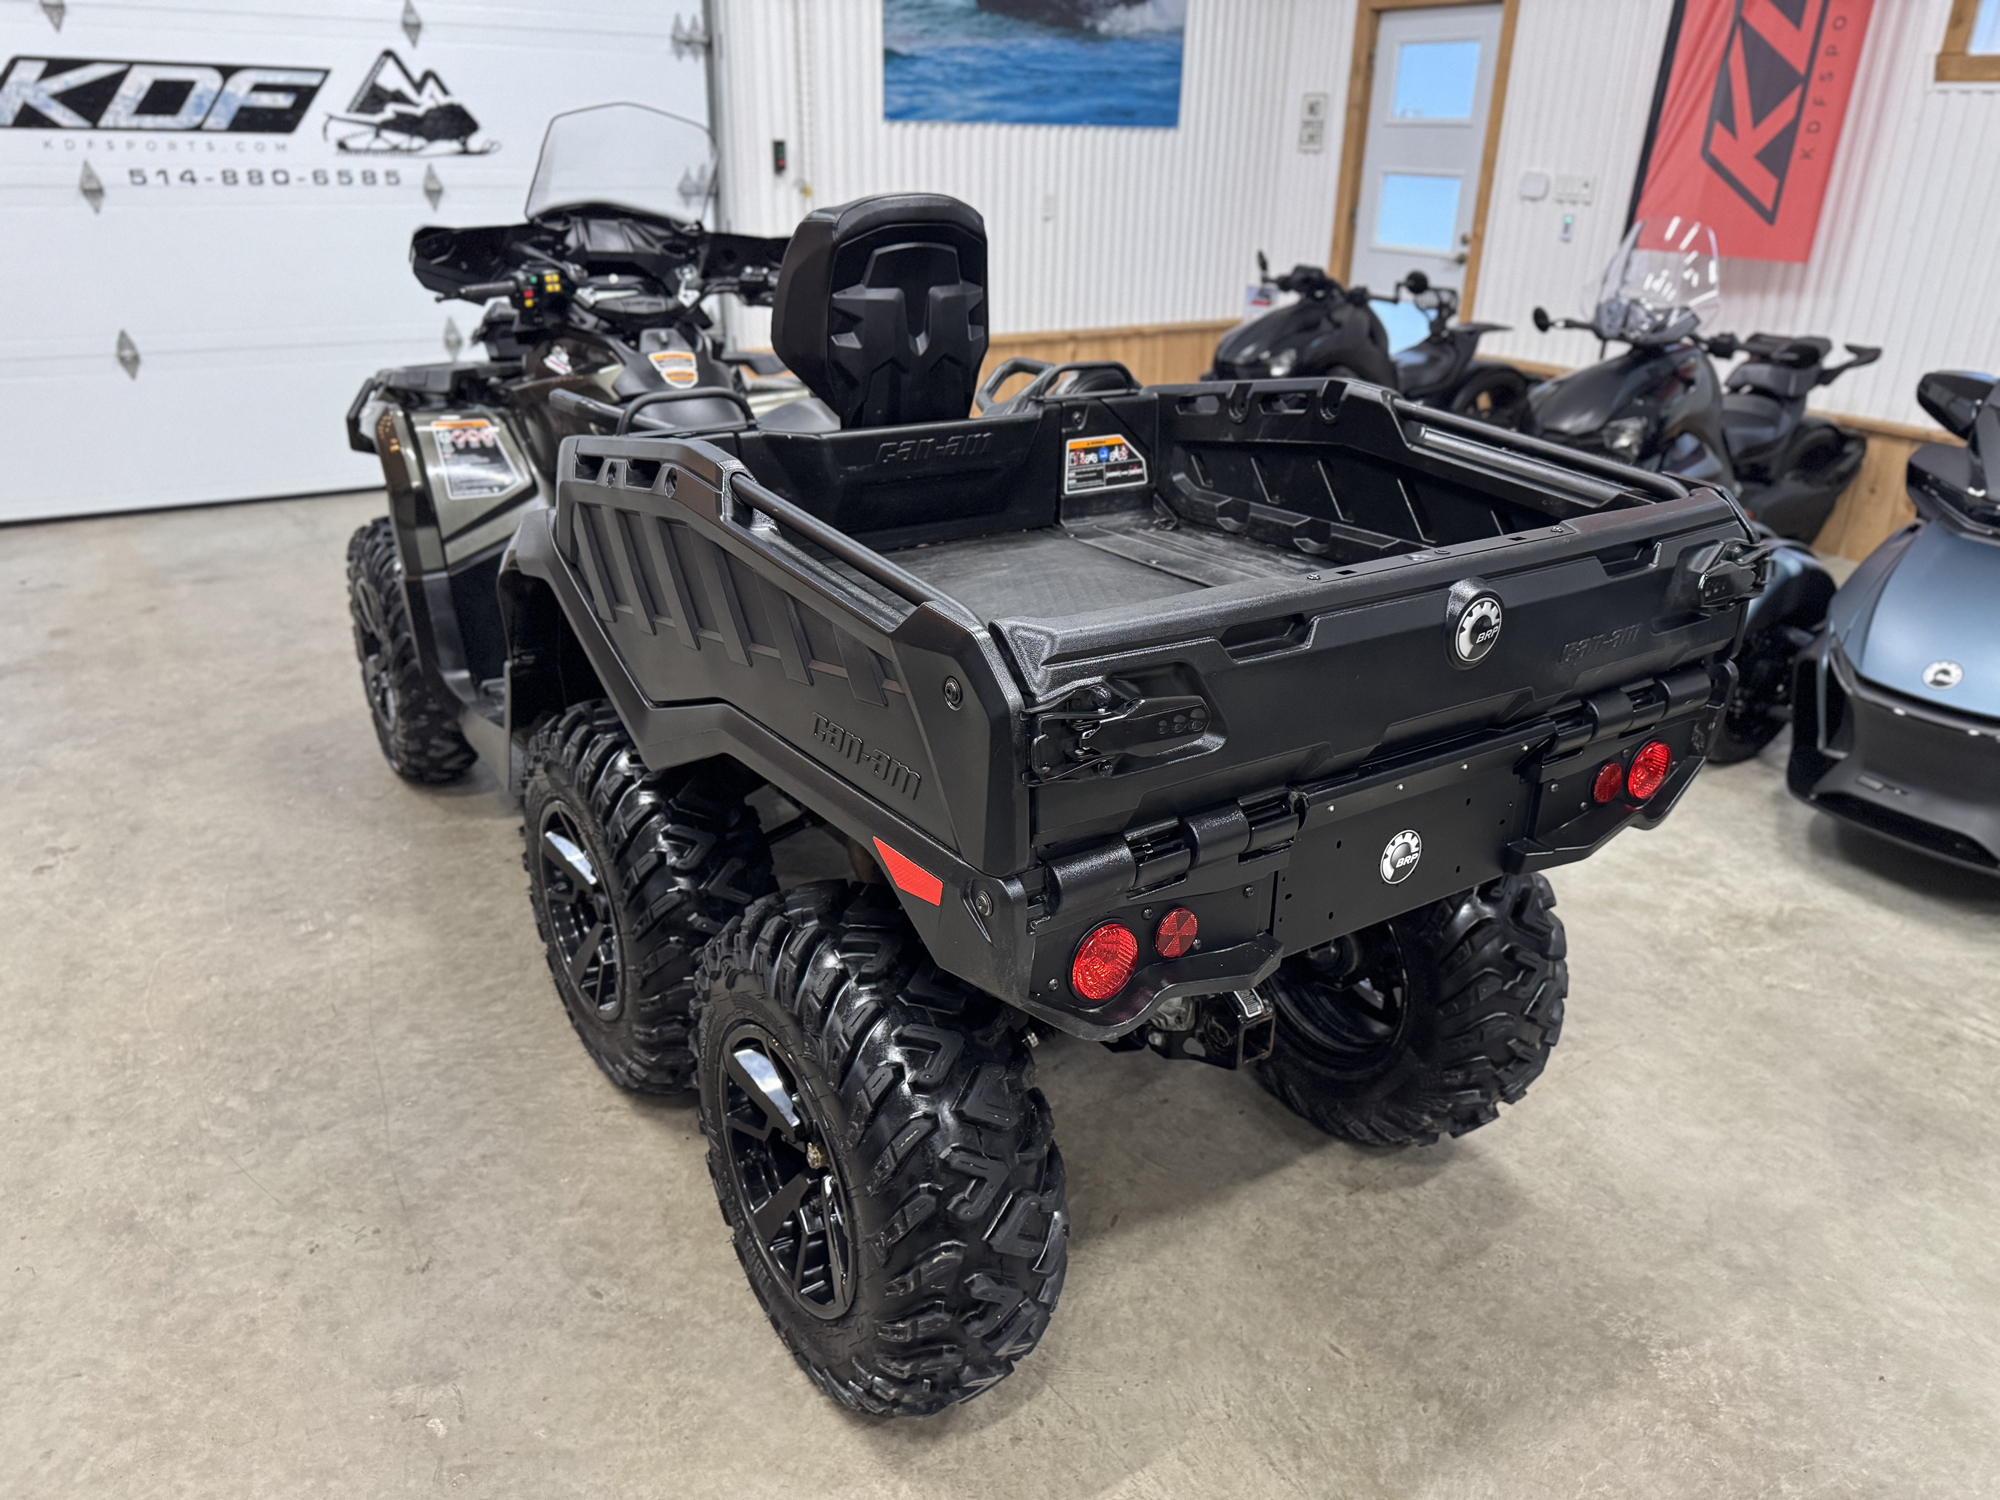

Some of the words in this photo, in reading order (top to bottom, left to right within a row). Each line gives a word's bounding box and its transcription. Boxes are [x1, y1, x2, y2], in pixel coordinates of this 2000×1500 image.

[0, 59, 327, 129] KDF
[43, 138, 289, 153] KDFSPORTS.COM
[128, 168, 402, 187] 514-880-6585
[1475, 625, 1500, 644] BRP
[812, 711, 922, 801] can-am
[1395, 852, 1419, 869] BRP
